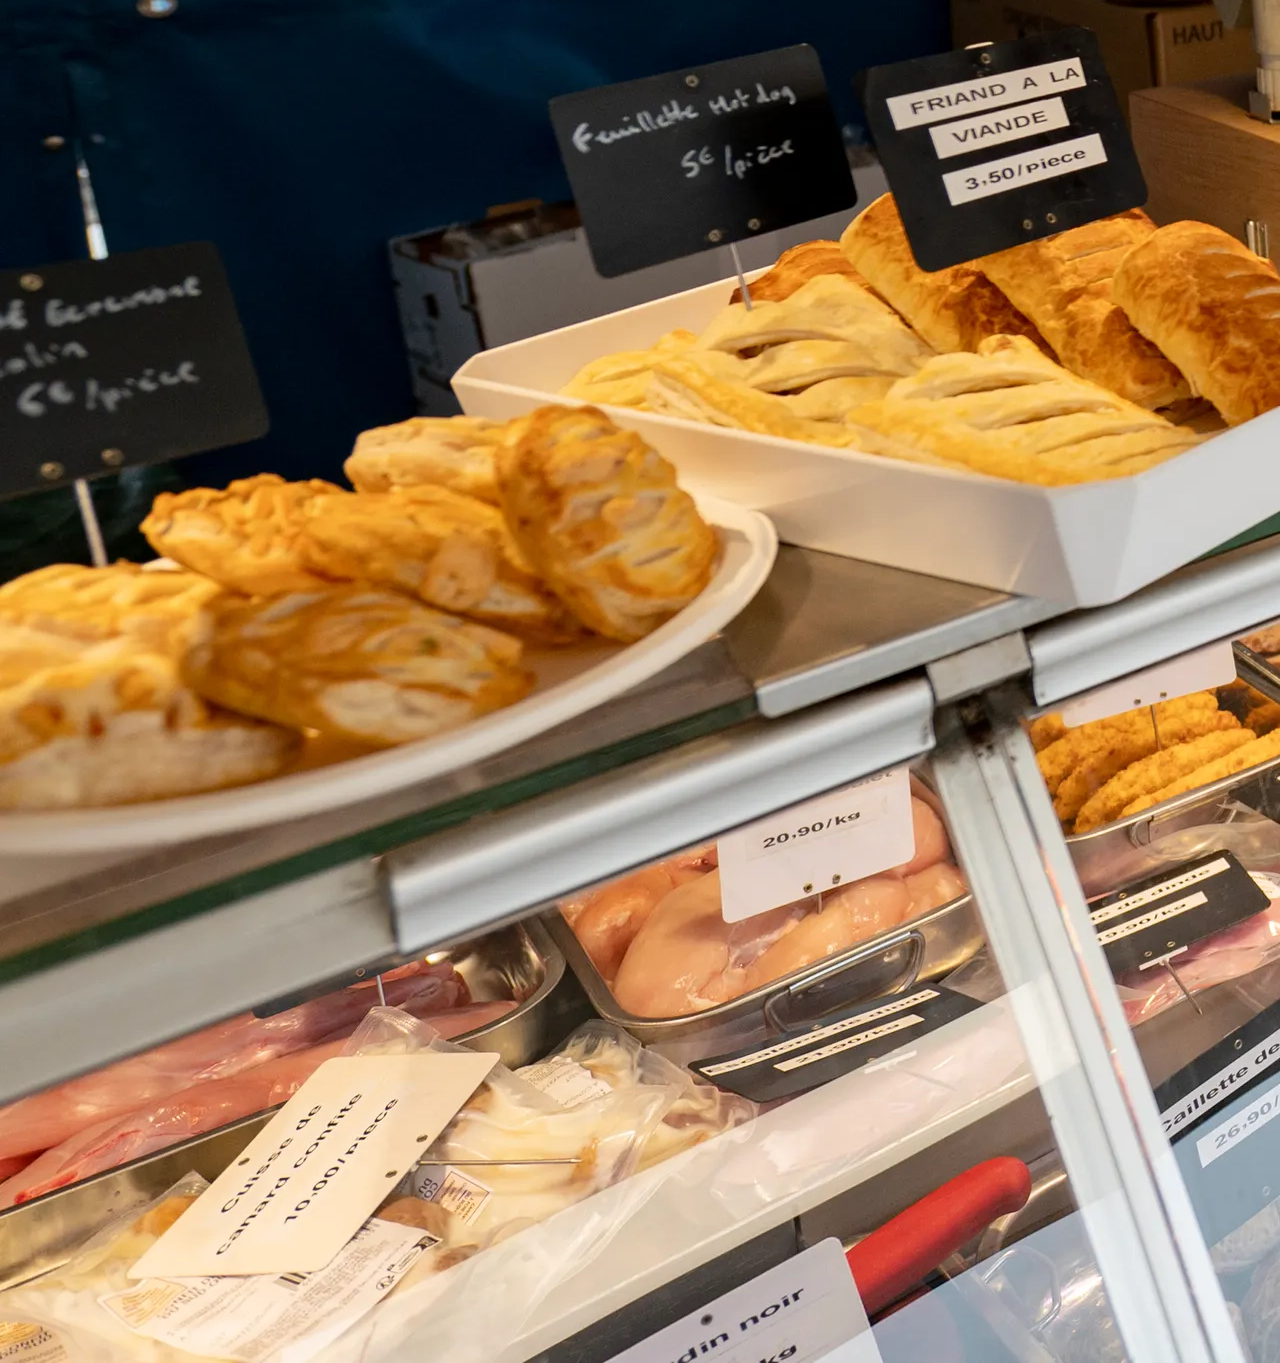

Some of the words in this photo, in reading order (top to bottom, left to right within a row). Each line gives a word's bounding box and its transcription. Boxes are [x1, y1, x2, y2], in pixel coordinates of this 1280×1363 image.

[1172, 20, 1225, 46] HAUT
[755, 82, 797, 106] dog
[910, 83, 1007, 115] FRIAND
[1022, 76, 1038, 90] A
[1049, 67, 1080, 84] LA
[952, 110, 1049, 144] VIANDE
[964, 148, 1087, 191] 3,50/piece
[763, 810, 861, 850] 20,90/kg
[1152, 869, 1211, 895] dinde
[832, 1021, 855, 1032] de
[1254, 1042, 1280, 1066] de
[216, 1175, 291, 1256] canard
[293, 1093, 363, 1170] confite
[221, 1136, 294, 1214] Cuisse
[295, 1104, 323, 1131] de
[740, 1288, 805, 1332] noir
